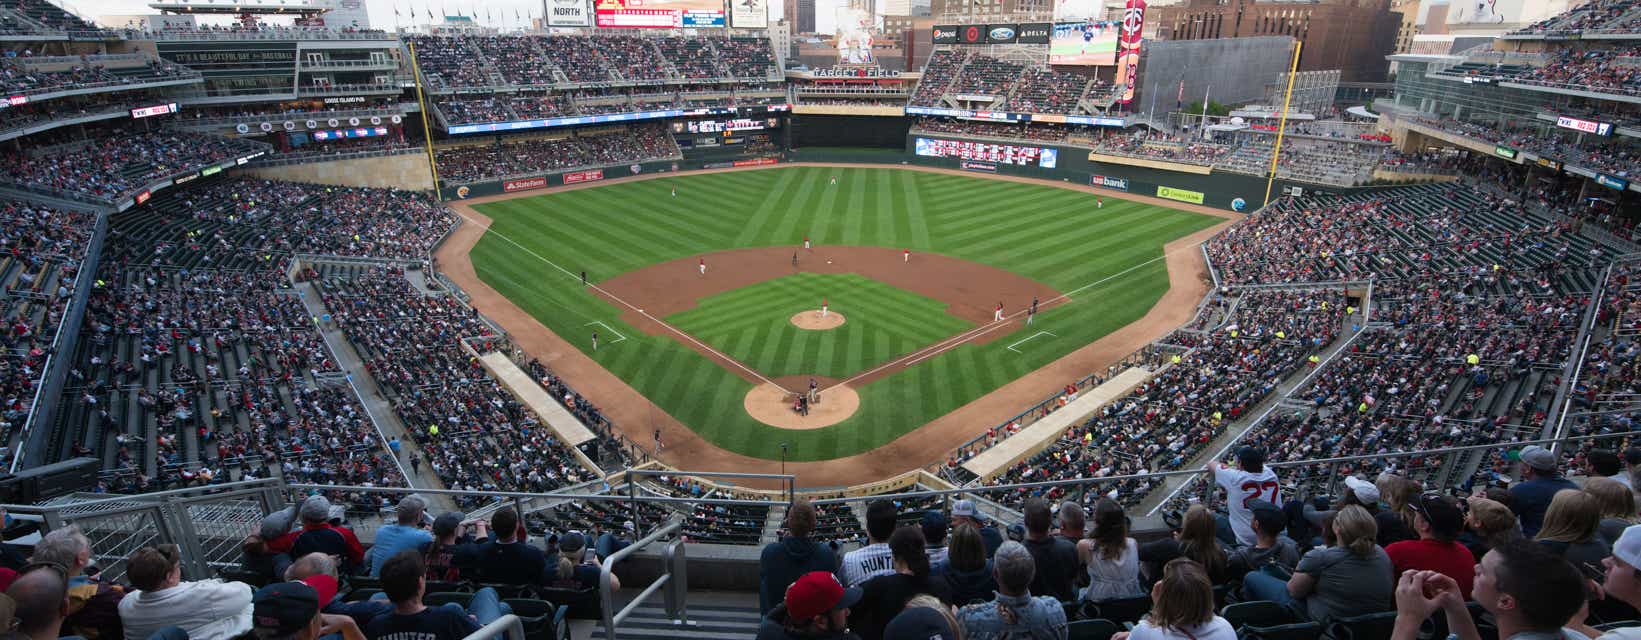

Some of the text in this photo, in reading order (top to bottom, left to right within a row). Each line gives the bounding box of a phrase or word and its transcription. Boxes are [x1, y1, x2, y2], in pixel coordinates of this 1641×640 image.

[553, 7, 581, 16] NORTH
[813, 69, 899, 77] TARGET FIELD
[1558, 118, 1572, 126] TWINS
[1241, 481, 1278, 509] 27
